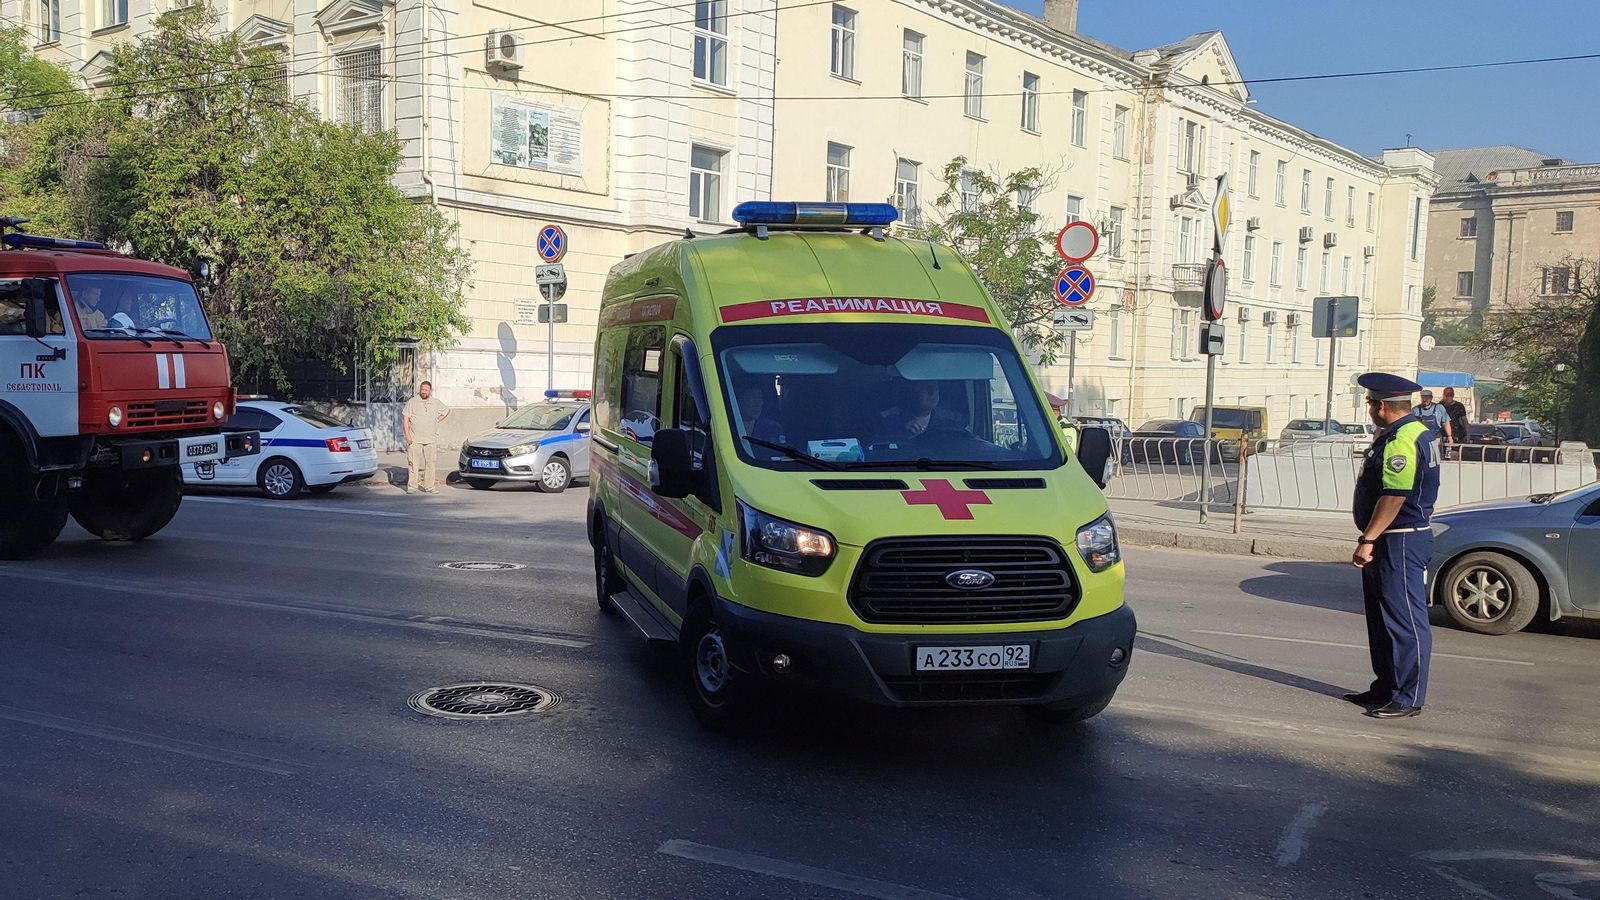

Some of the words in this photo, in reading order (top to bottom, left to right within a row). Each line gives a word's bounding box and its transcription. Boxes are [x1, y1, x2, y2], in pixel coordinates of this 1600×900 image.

[770, 298, 944, 315] РЕАНИМАЦИЯ
[20, 363, 46, 379] ПК
[6, 383, 62, 392] СЕВАСТОПОЛЬ
[957, 573, 986, 585] Ford
[1005, 647, 1024, 661] 92
